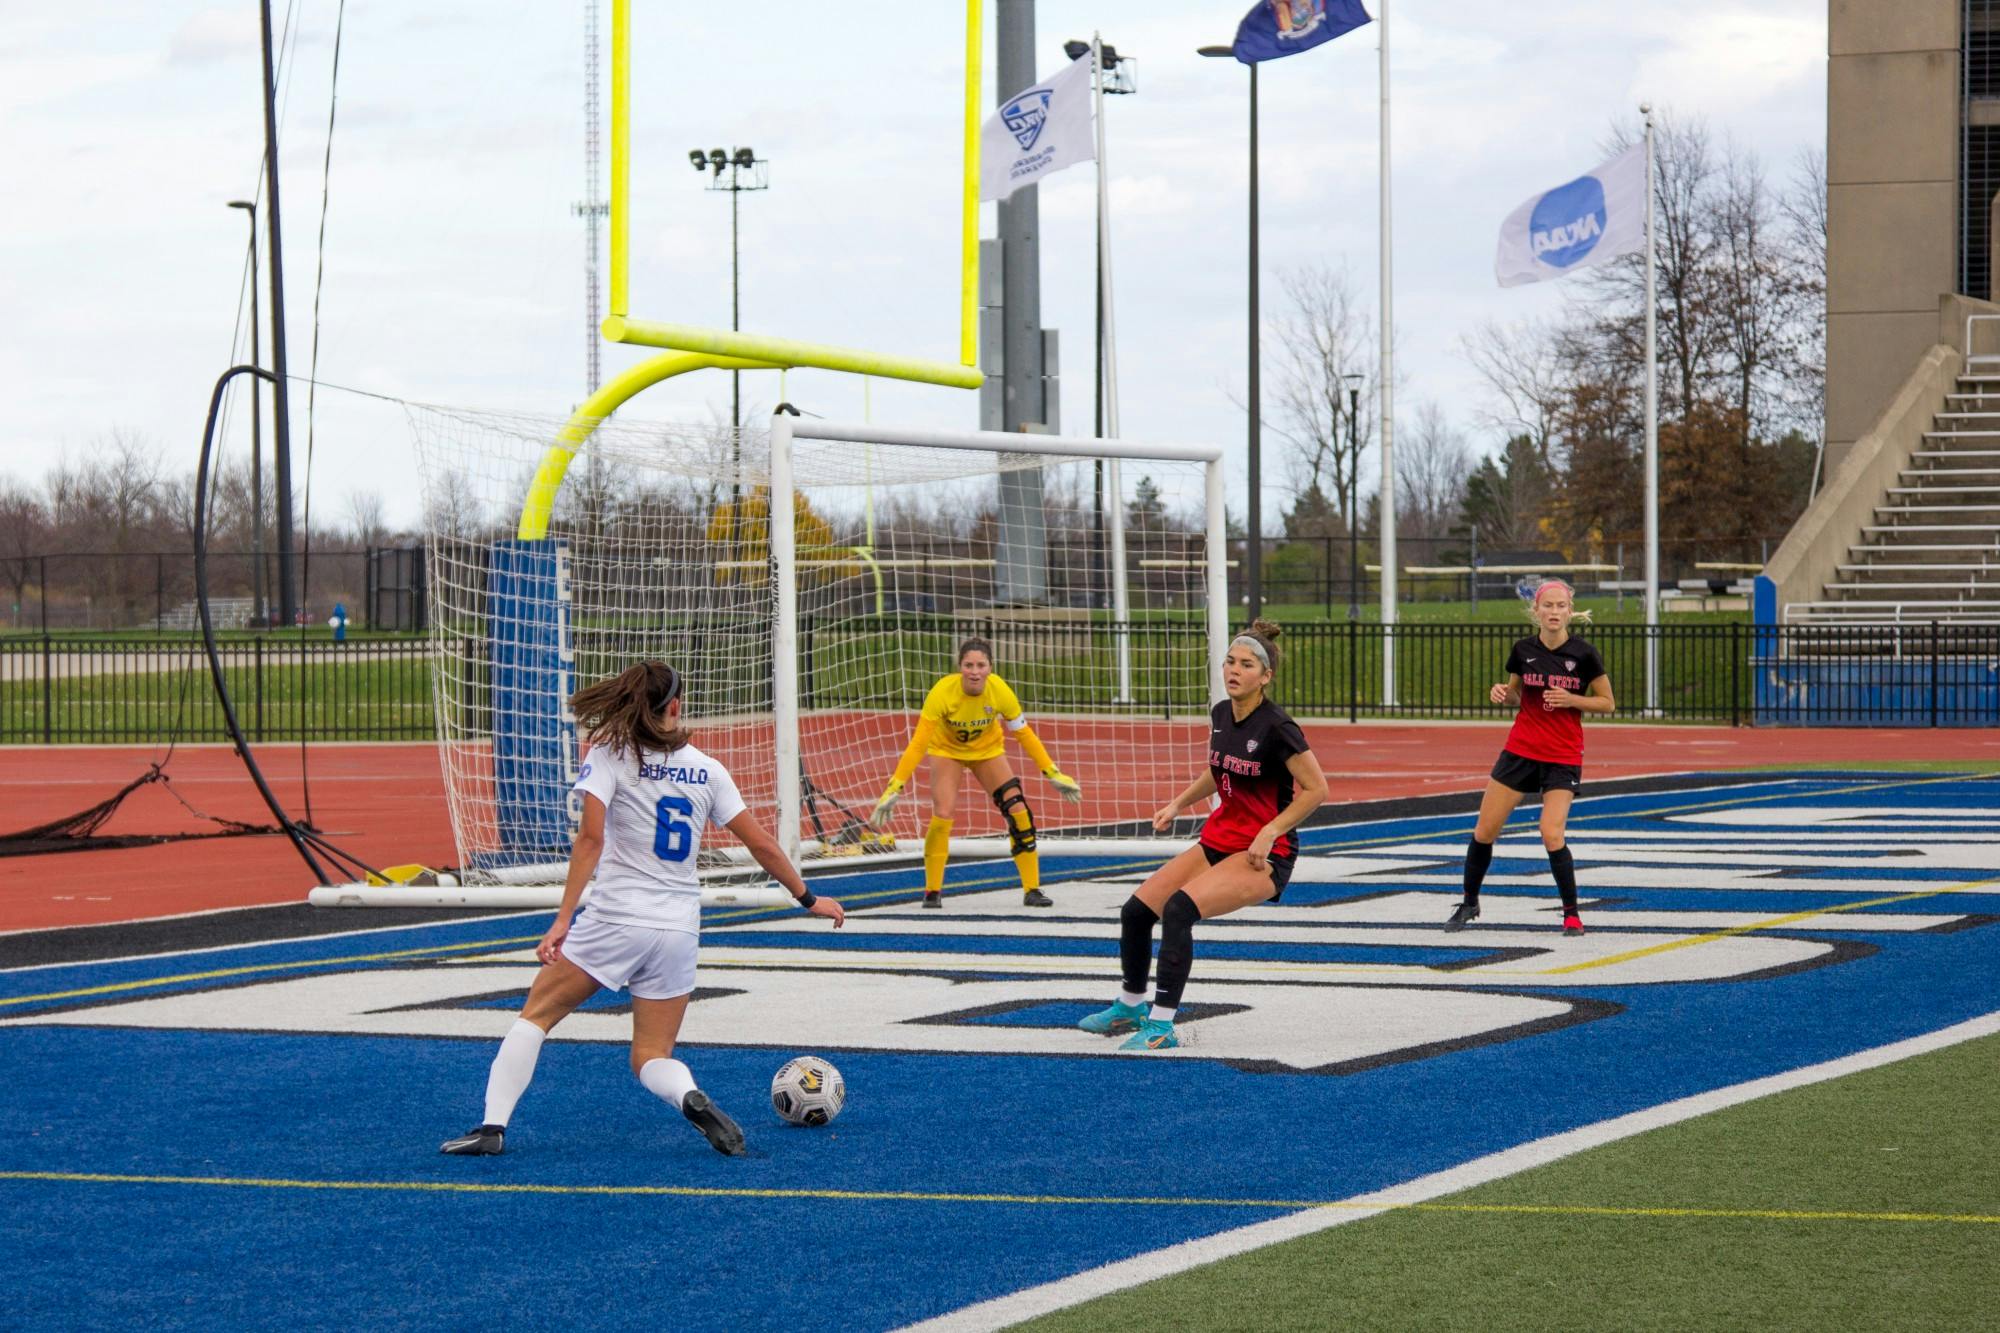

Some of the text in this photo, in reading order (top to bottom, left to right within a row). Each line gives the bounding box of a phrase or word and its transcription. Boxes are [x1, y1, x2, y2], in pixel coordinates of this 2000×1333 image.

[639, 763, 708, 785] BUFFALO
[1209, 750, 1262, 777] LL STATE
[653, 795, 694, 863] 6
